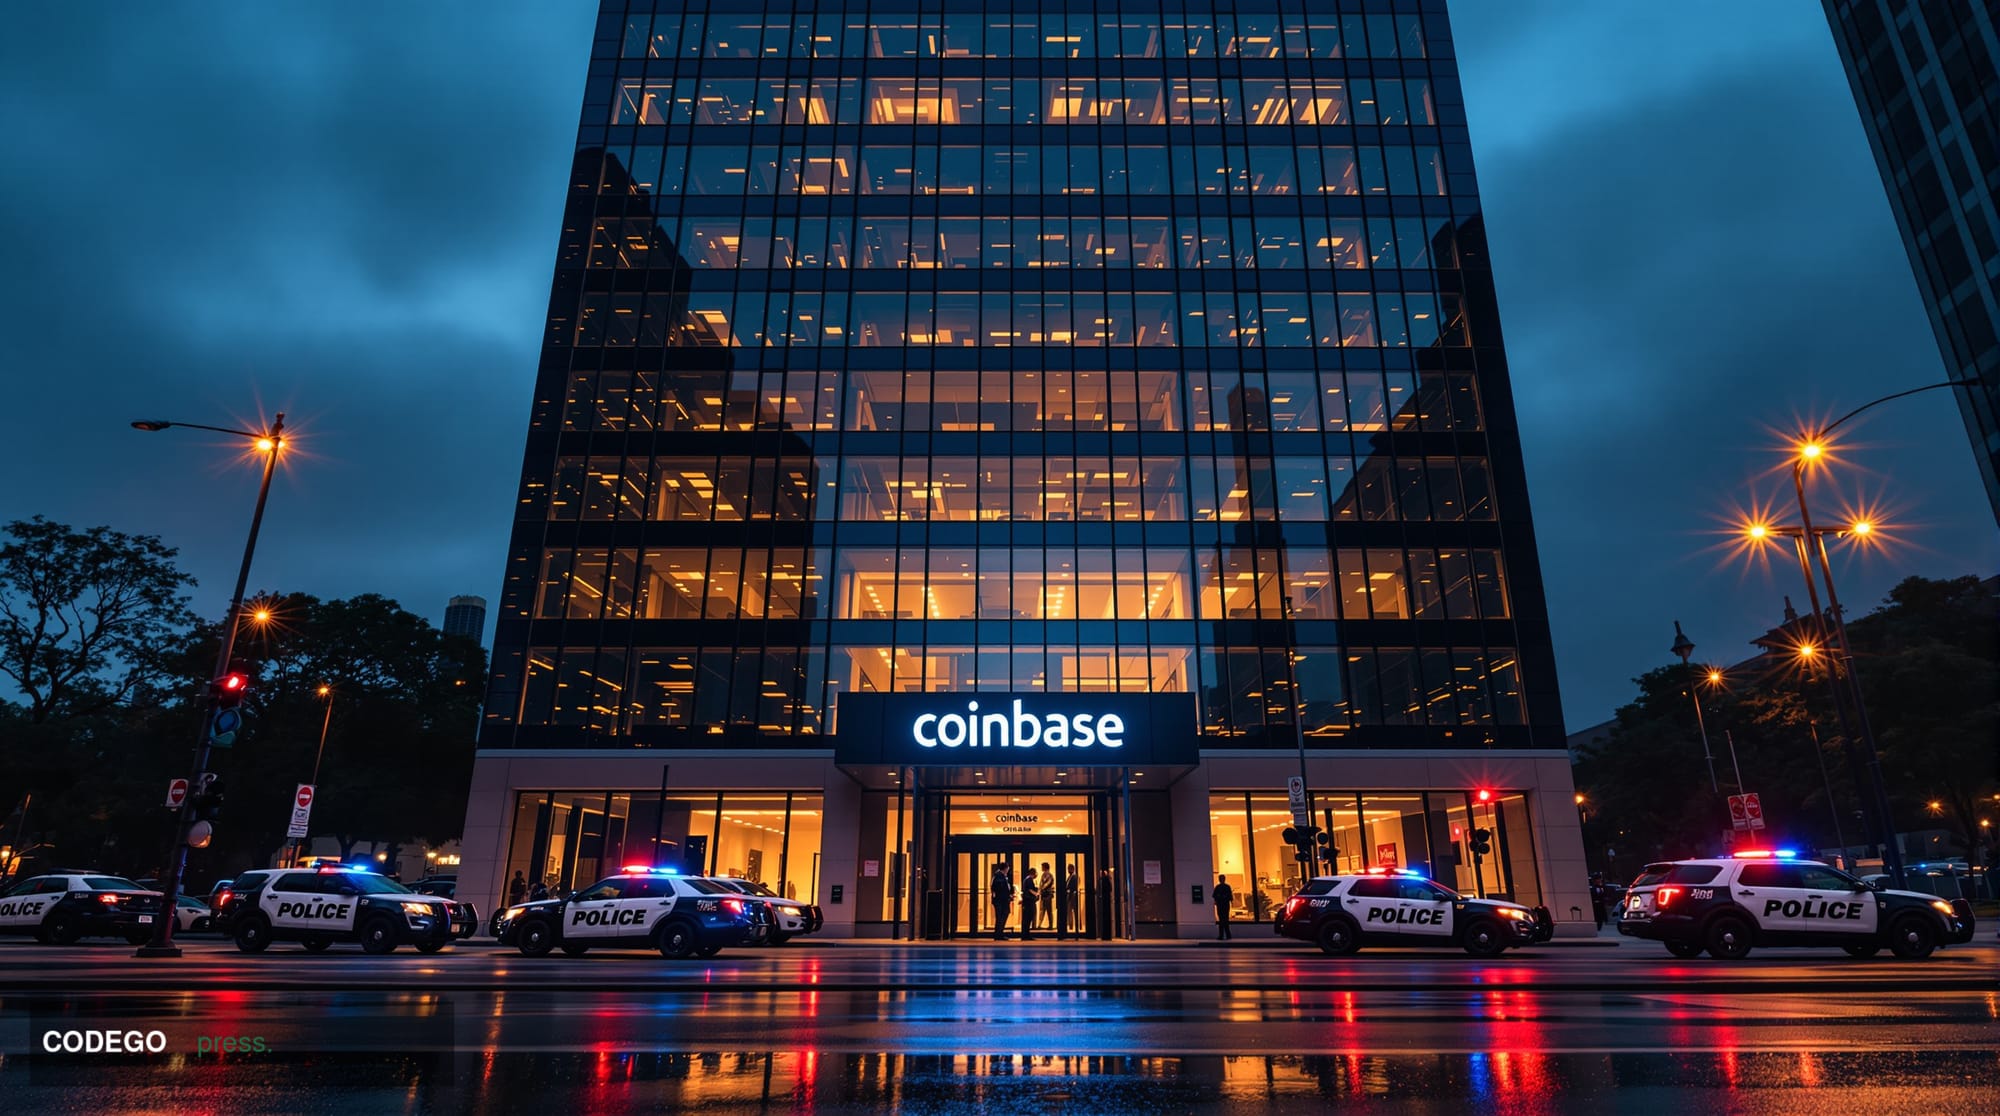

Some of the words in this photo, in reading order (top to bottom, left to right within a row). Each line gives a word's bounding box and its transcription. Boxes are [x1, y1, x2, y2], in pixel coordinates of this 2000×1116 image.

[913, 699, 1125, 748] coinbase
[996, 812, 1038, 822] coinbase
[0, 902, 45, 916] OLICE
[278, 902, 351, 920] POLICE
[572, 909, 647, 927] POLICE
[1366, 907, 1445, 926] POLICE
[1763, 899, 1863, 920] POLICE
